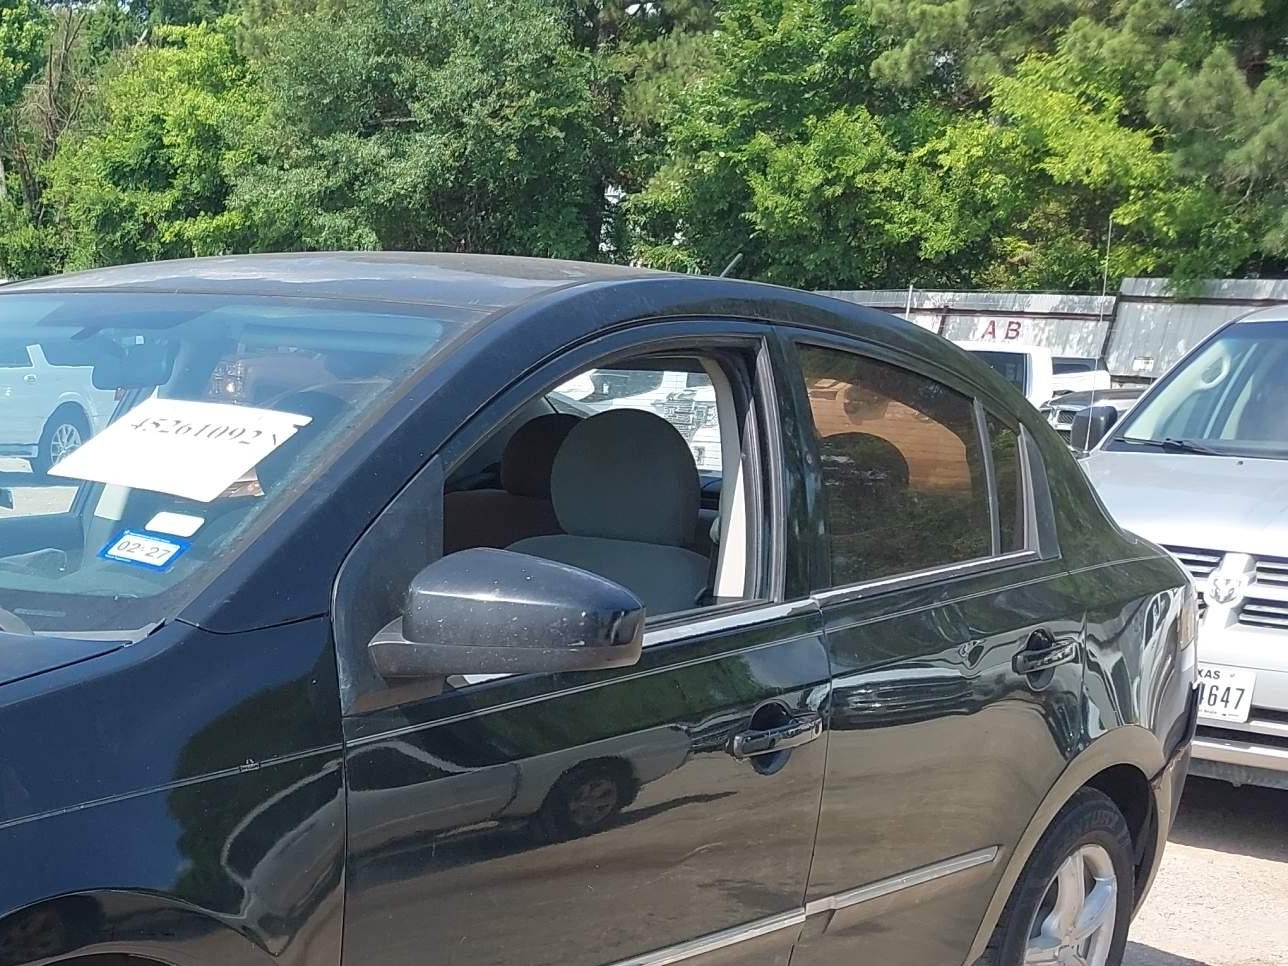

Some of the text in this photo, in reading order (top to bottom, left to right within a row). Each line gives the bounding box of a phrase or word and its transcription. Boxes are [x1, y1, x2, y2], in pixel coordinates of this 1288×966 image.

[981, 319, 1022, 340] A B
[1198, 669, 1221, 680] XAS
